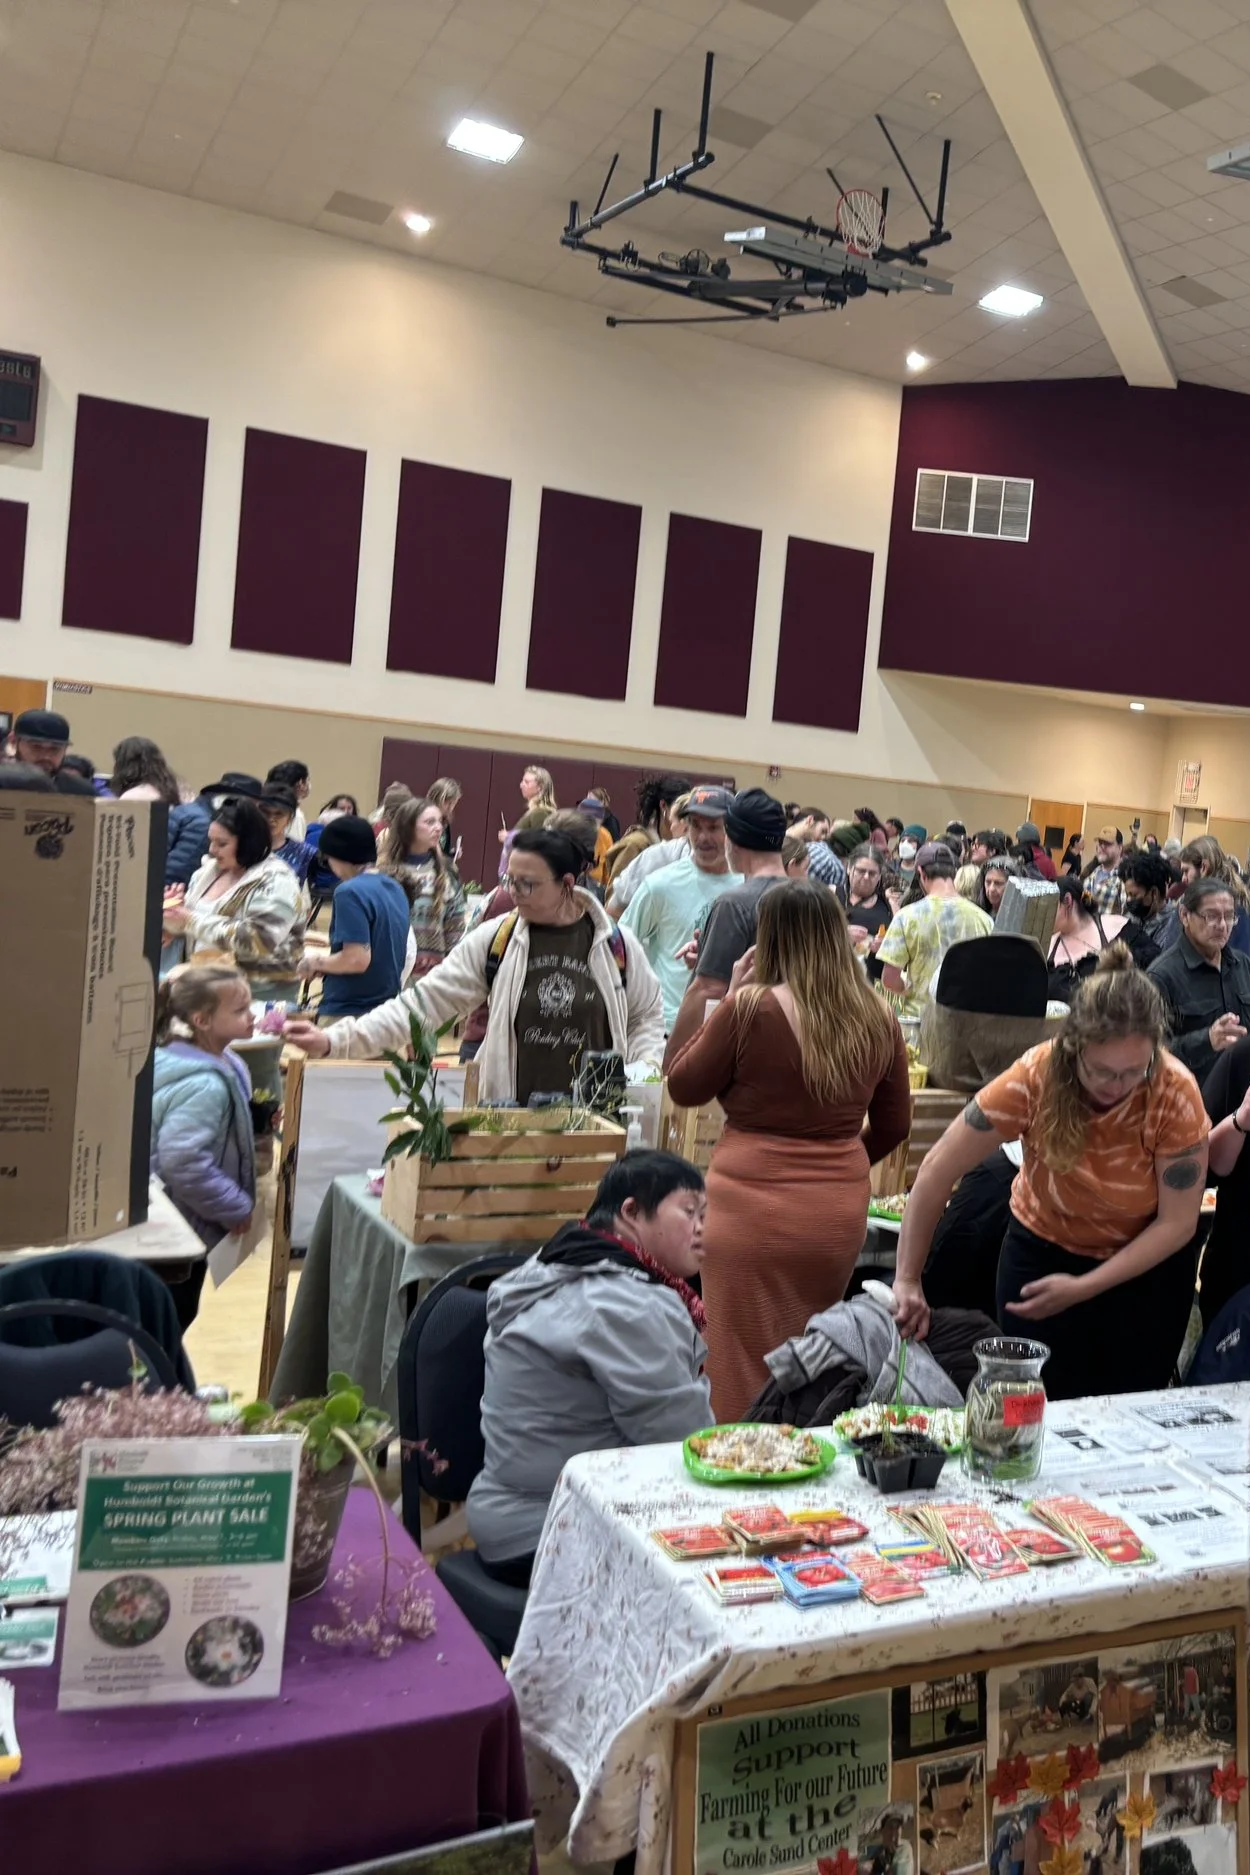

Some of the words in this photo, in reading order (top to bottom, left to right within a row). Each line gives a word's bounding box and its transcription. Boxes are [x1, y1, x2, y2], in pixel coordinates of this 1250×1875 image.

[103, 860, 111, 888] para
[109, 860, 121, 935] Presentation
[98, 891, 110, 980] presentaciones
[104, 1495, 163, 1507] Humboldt
[165, 1493, 221, 1507] Botanical
[221, 1490, 272, 1505] Garden's
[123, 1480, 170, 1493] Support
[173, 1479, 194, 1490] Our
[196, 1478, 240, 1490] Growth
[243, 1478, 255, 1489] at
[104, 1510, 167, 1529] SPRING
[171, 1508, 225, 1526] PLANT
[229, 1506, 270, 1524] SALE
[734, 1721, 760, 1754] All
[767, 1708, 860, 1738] Donations
[732, 1739, 860, 1785] Support
[700, 1782, 770, 1824] Farming
[774, 1777, 802, 1807] For
[805, 1775, 833, 1800] our
[837, 1761, 888, 1793] Future
[728, 1809, 772, 1841] at
[787, 1794, 857, 1837] the
[723, 1846, 767, 1869] Carole
[769, 1837, 804, 1866] Sund
[808, 1823, 852, 1855] Center
